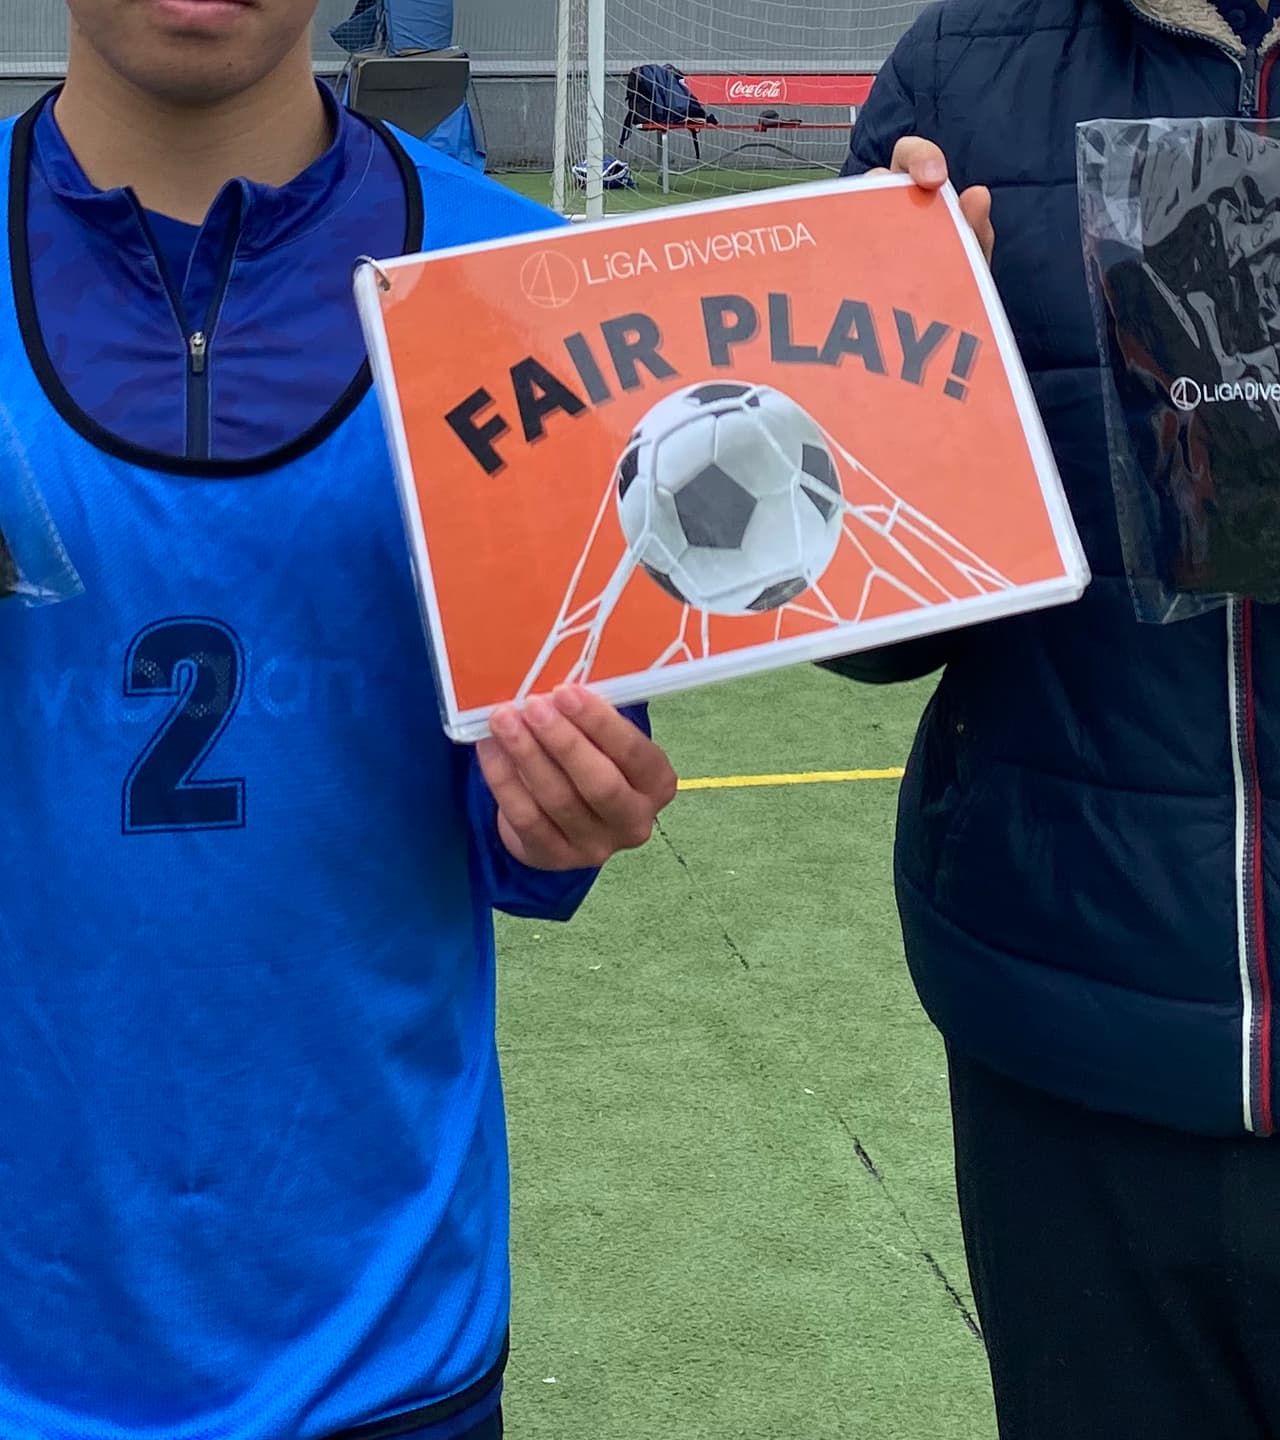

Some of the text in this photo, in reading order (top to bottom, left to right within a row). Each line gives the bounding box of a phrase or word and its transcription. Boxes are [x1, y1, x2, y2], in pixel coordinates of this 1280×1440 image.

[729, 80, 781, 98] Coca-Cola
[444, 292, 980, 477] FAIR PLAY!
[122, 615, 247, 836] 2
